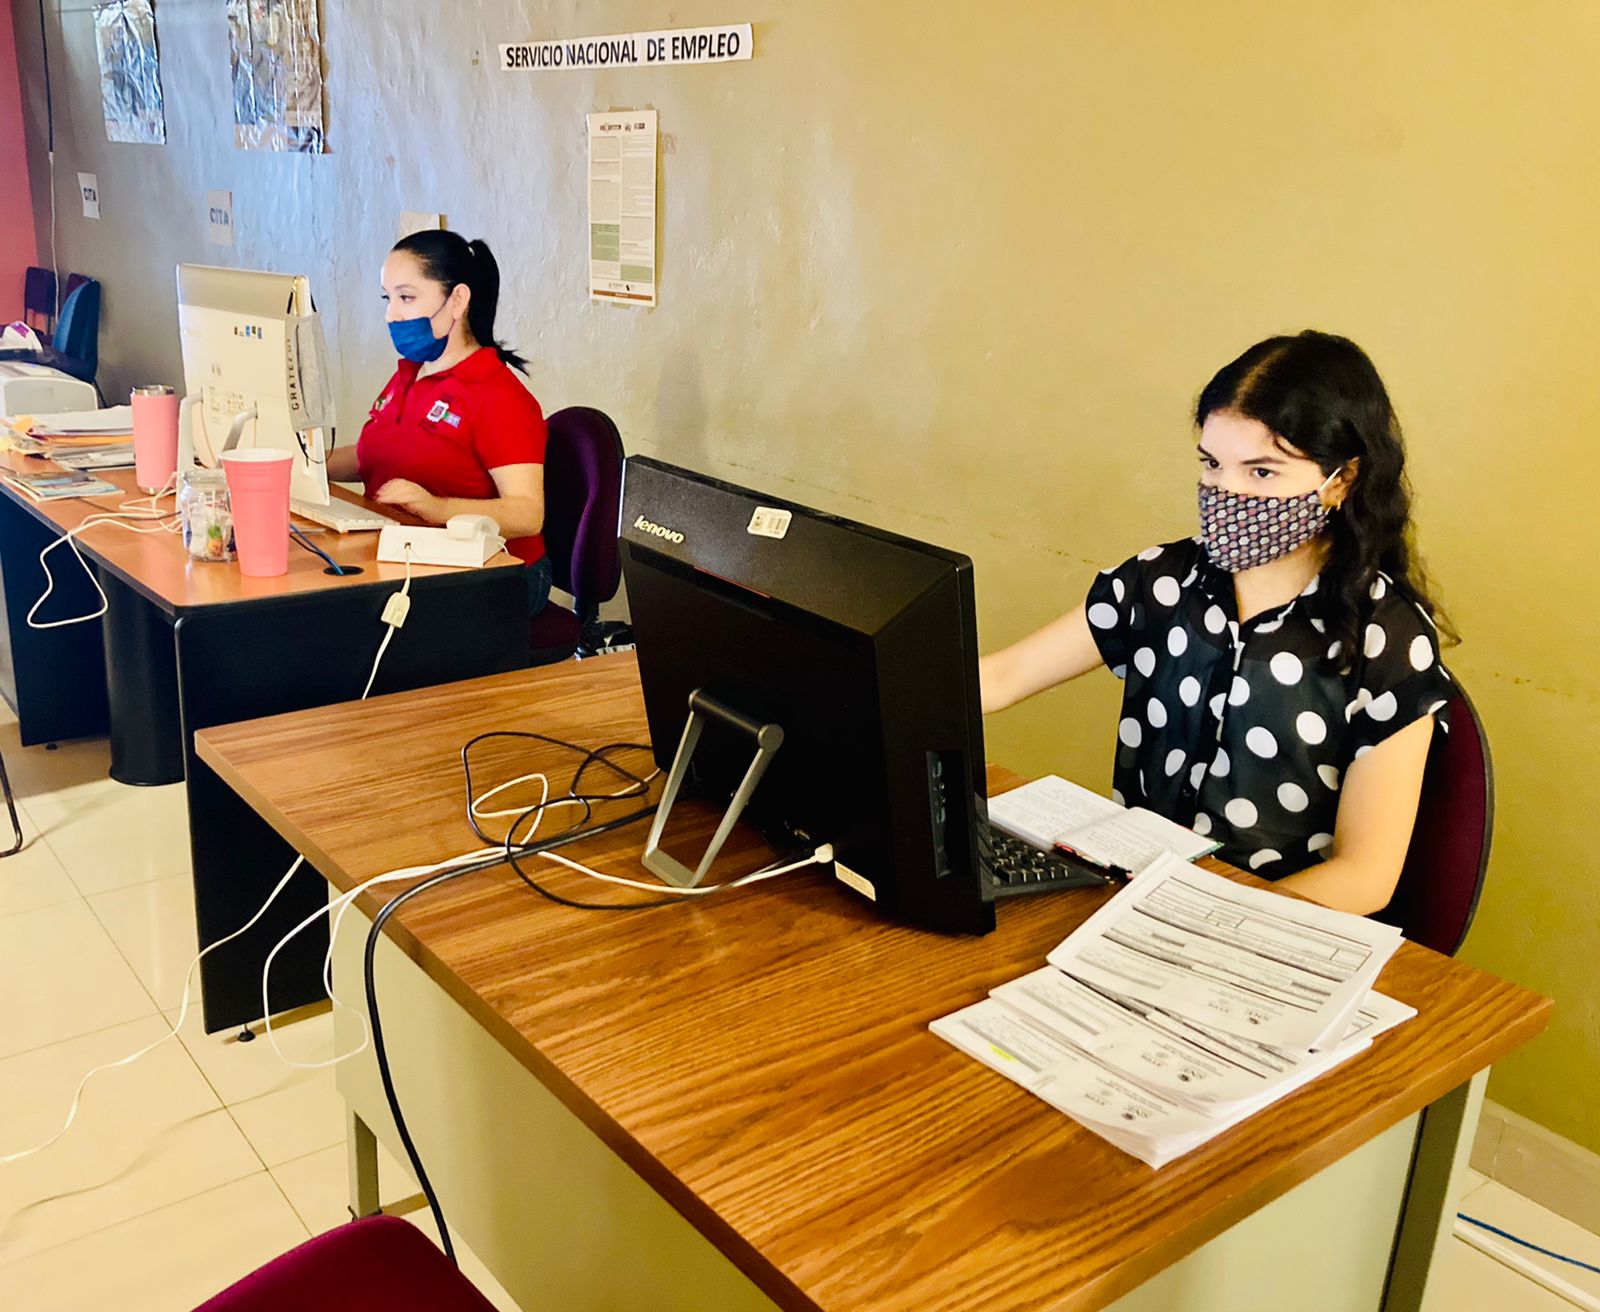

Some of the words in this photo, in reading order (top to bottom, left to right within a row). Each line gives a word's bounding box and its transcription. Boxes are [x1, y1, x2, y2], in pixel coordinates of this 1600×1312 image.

[506, 45, 563, 67] SERVICIO
[566, 39, 638, 65] NACIONAL
[646, 37, 666, 61] DE
[672, 31, 740, 60] EMPLEO
[83, 187, 98, 201] CITA
[209, 207, 230, 226] CITA
[633, 514, 685, 544] lenovo
